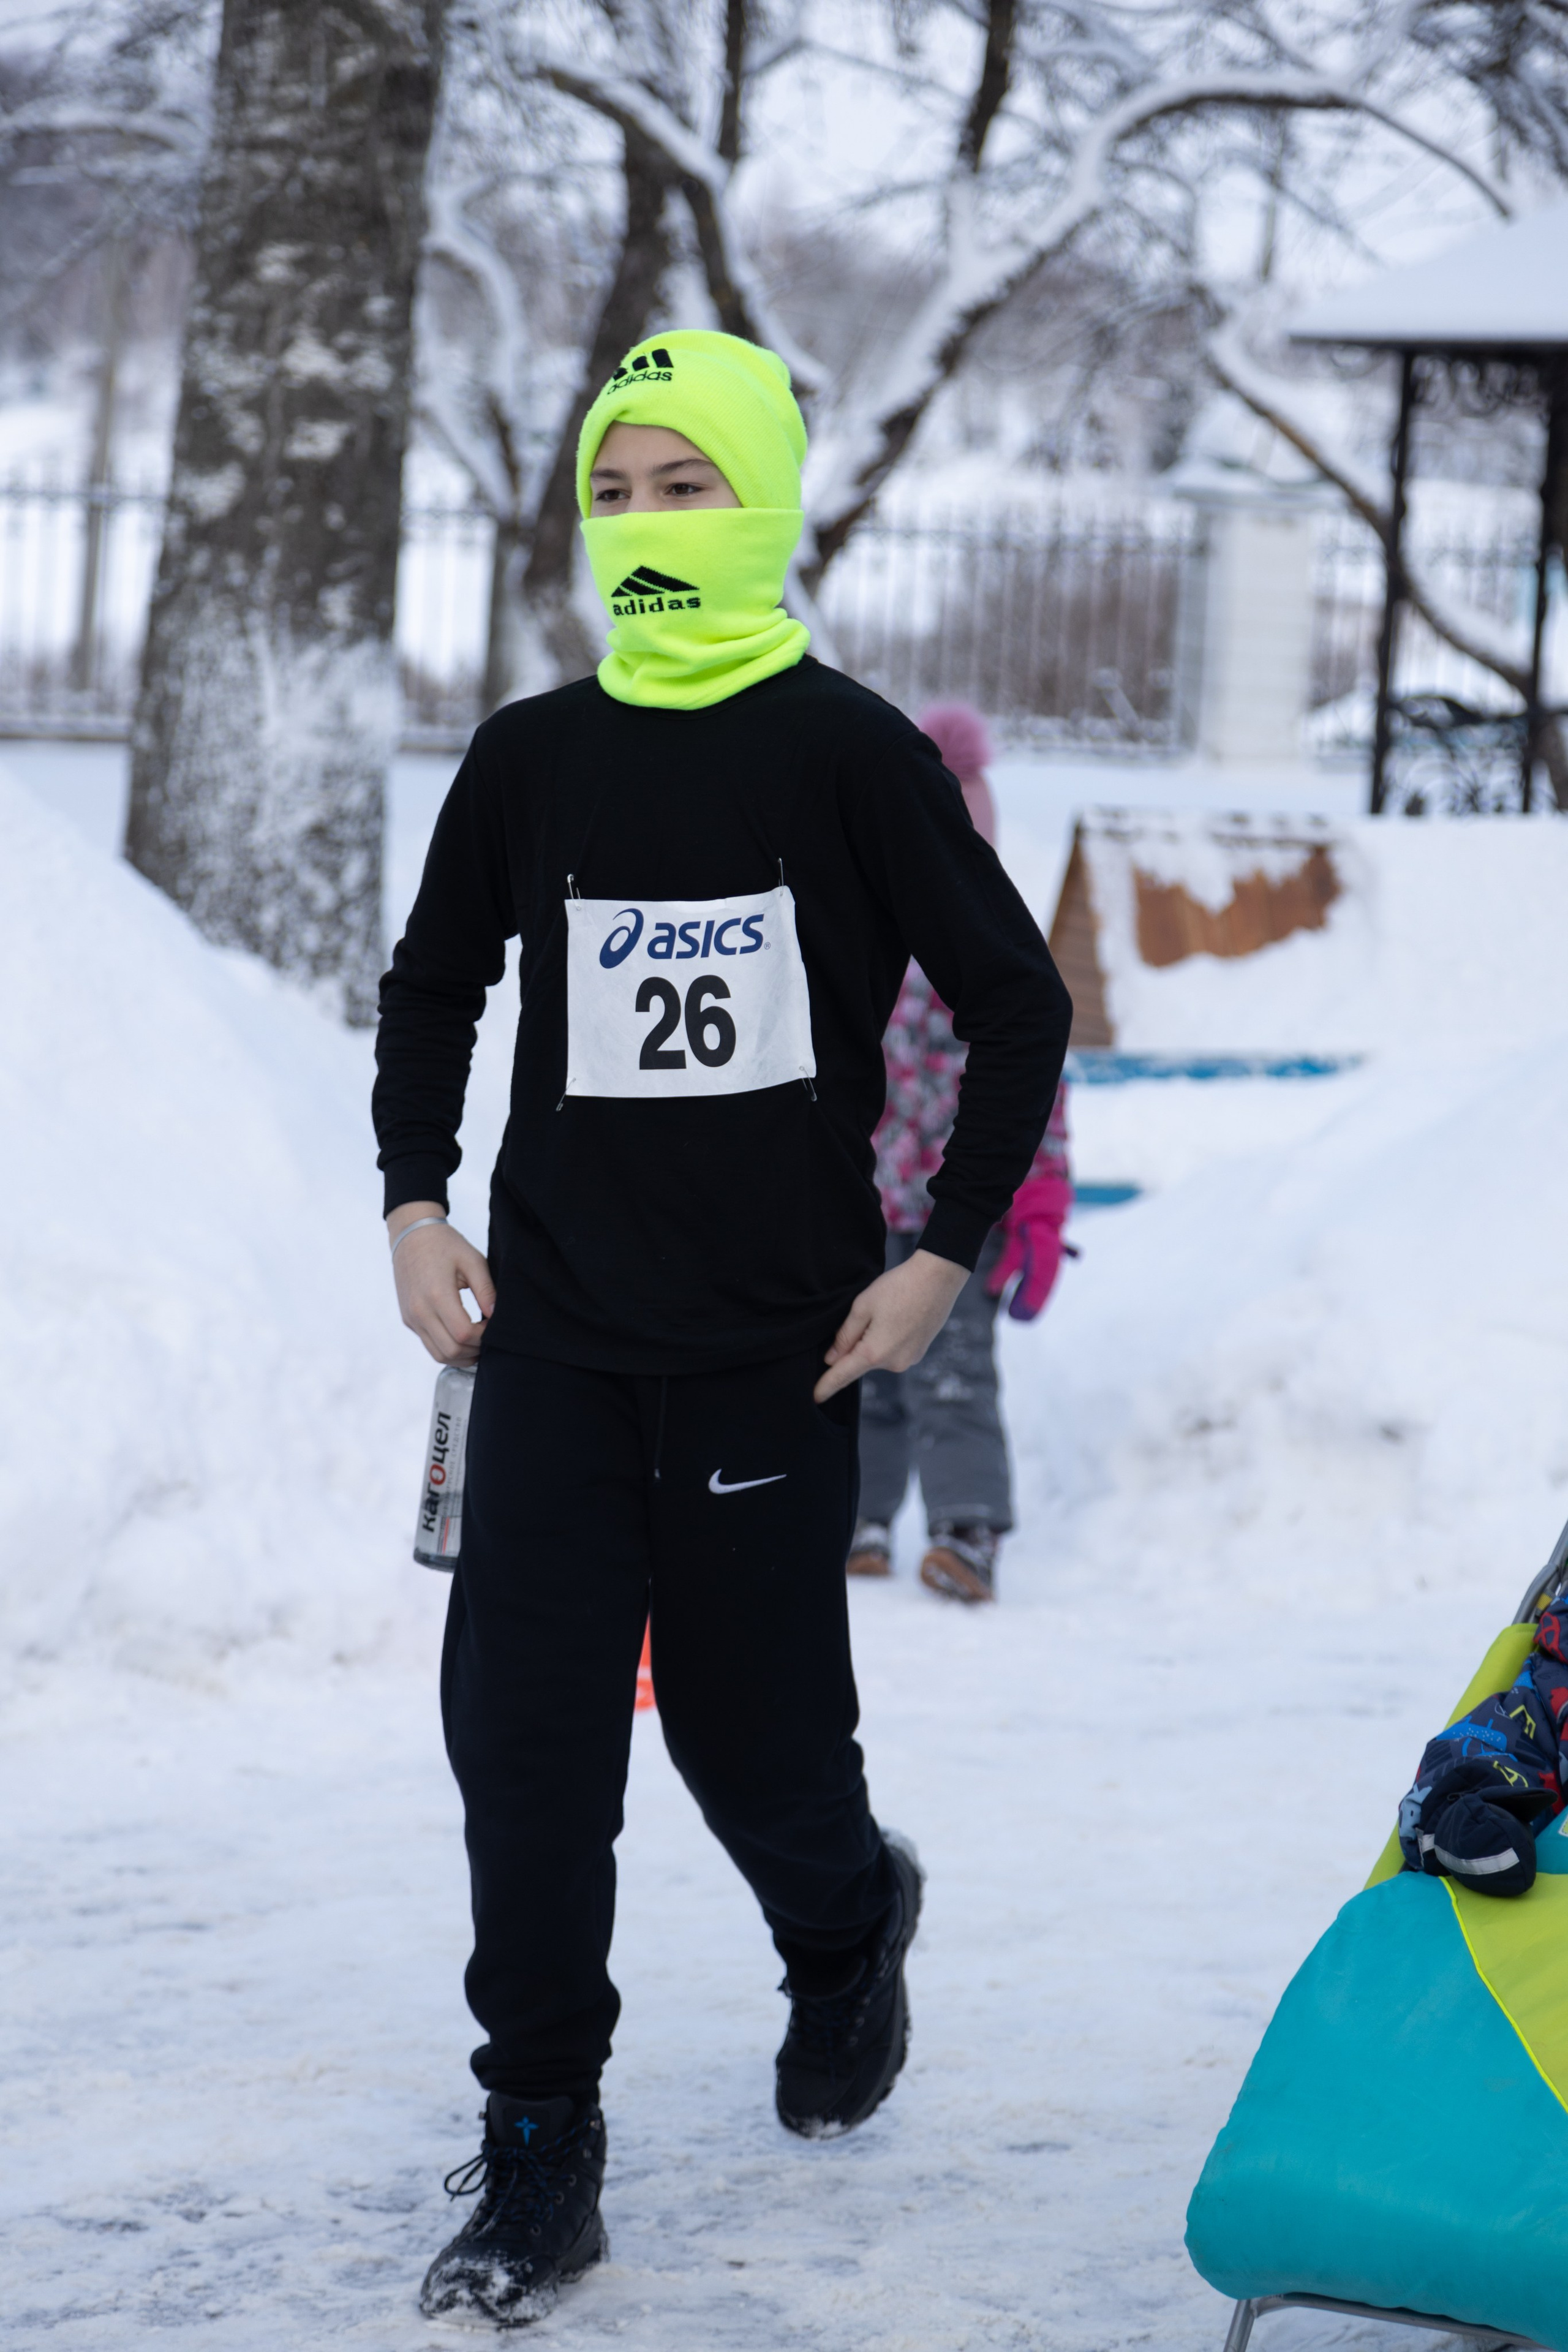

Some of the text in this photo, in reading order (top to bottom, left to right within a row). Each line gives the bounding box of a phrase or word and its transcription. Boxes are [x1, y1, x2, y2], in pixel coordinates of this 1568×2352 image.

[607, 371, 673, 394] adidas
[612, 597, 701, 616] adidas
[635, 974, 736, 1071] 26
